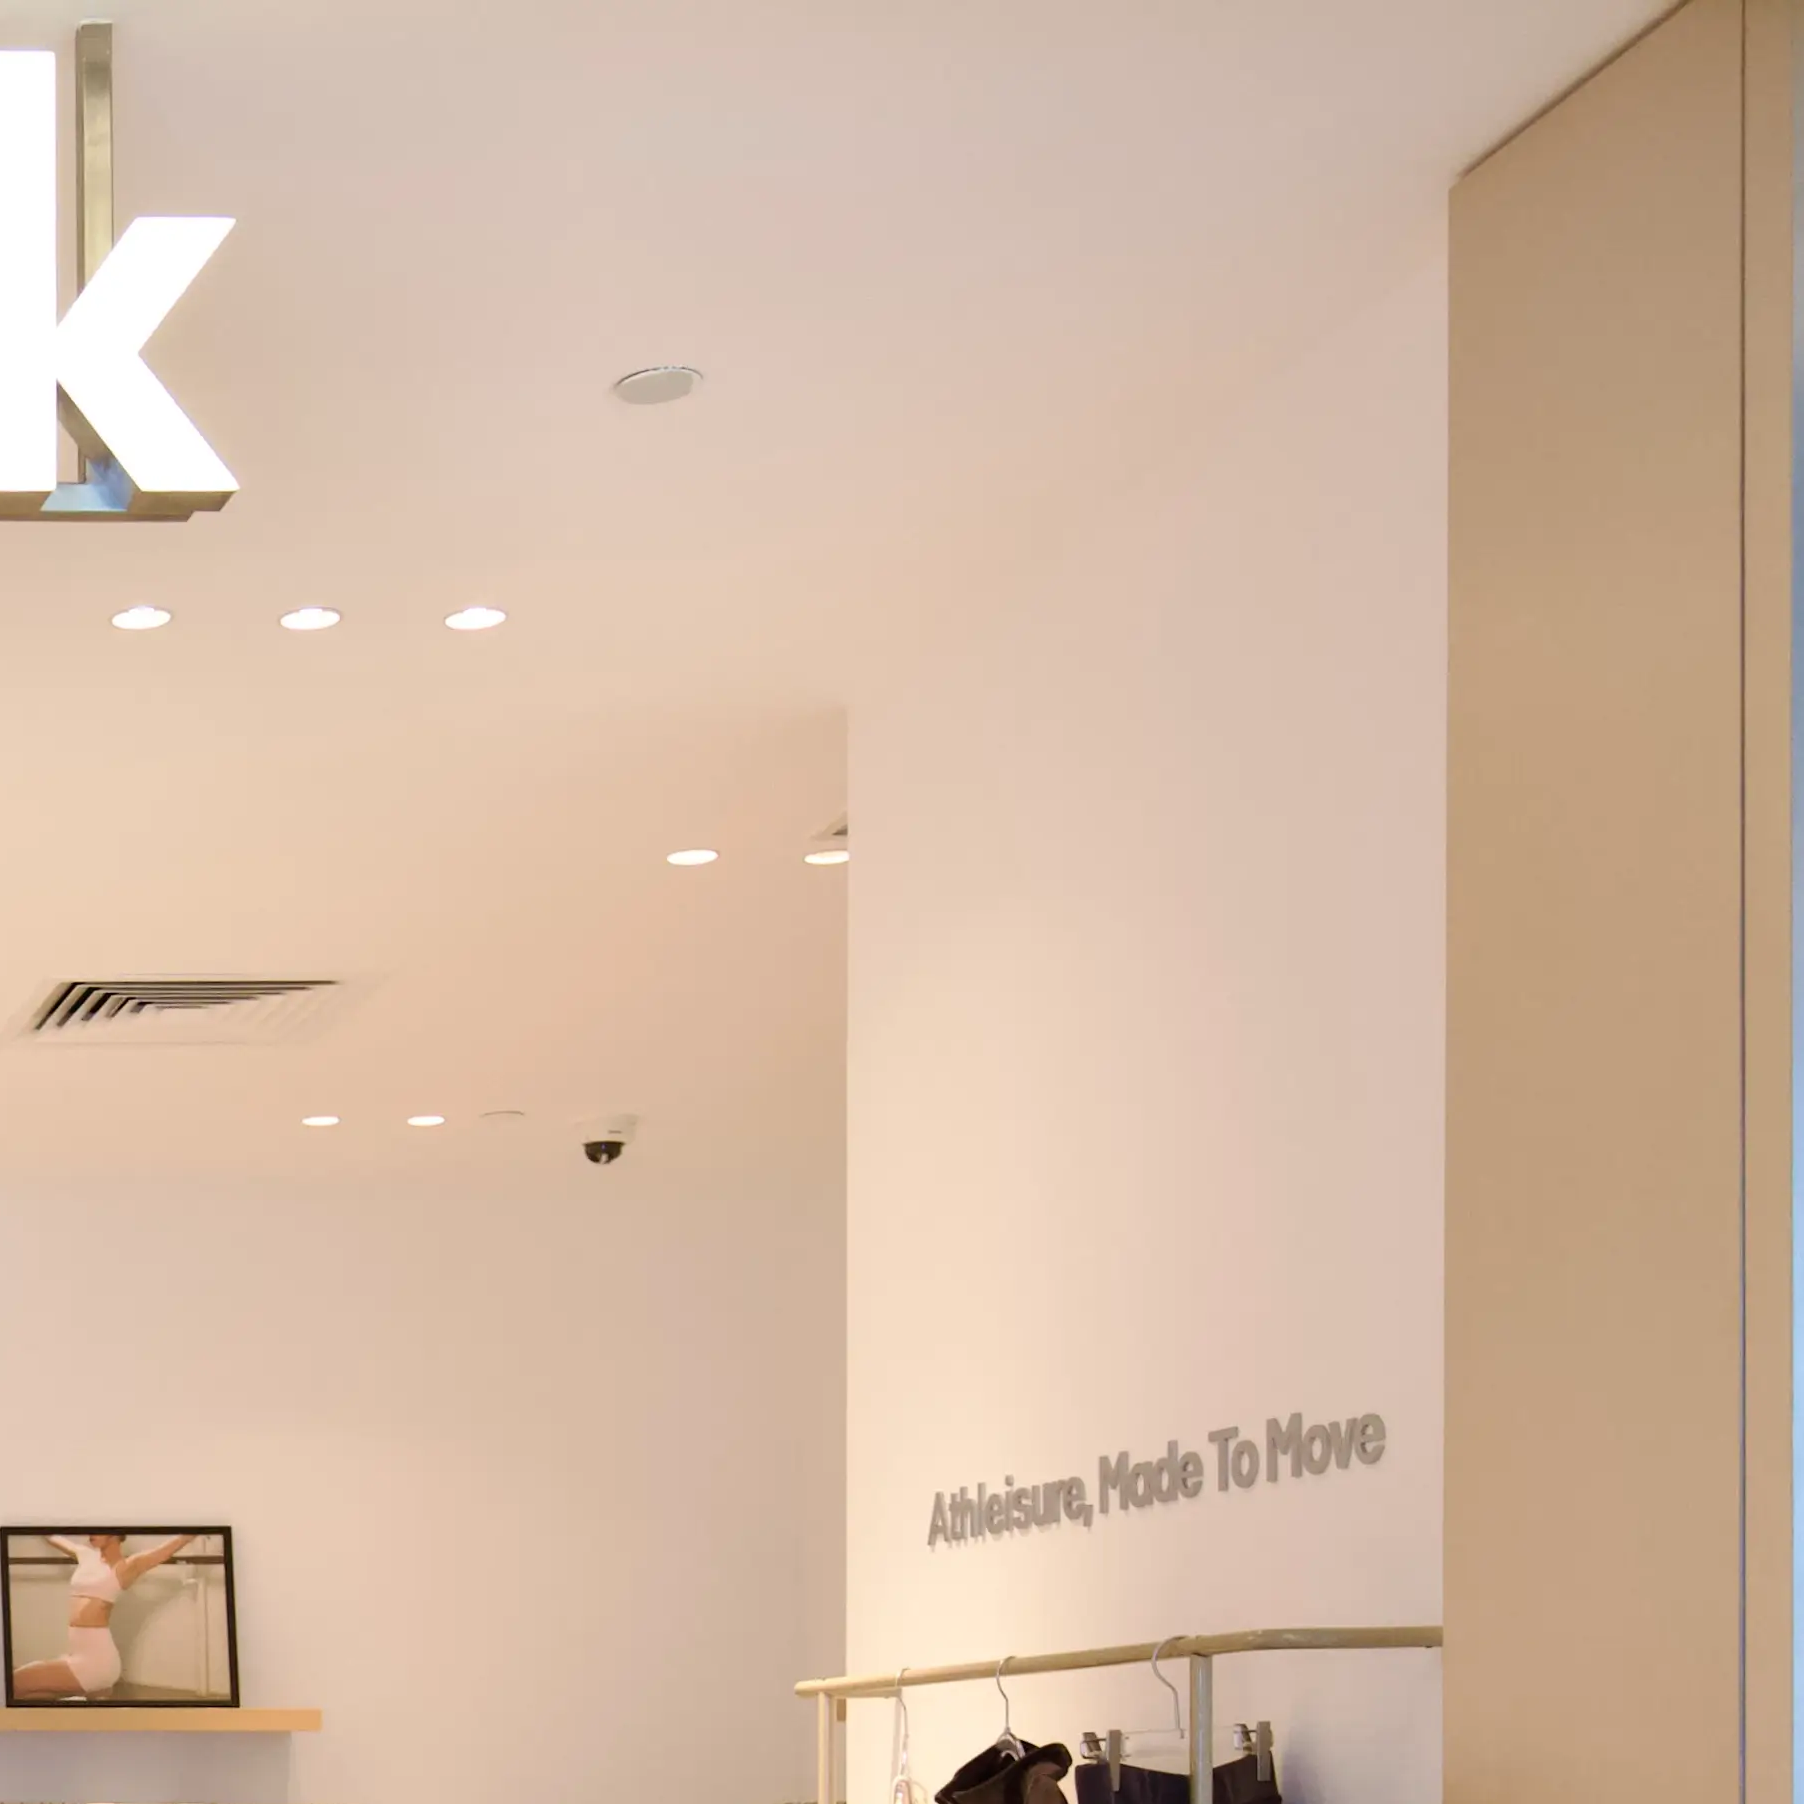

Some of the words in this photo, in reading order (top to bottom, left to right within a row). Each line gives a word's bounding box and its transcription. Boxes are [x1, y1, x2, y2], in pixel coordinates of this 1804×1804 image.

[927, 1474, 1094, 1546] Athleisure,
[1098, 1440, 1204, 1514] Made
[1207, 1426, 1259, 1491] To
[1265, 1412, 1387, 1483] Move
